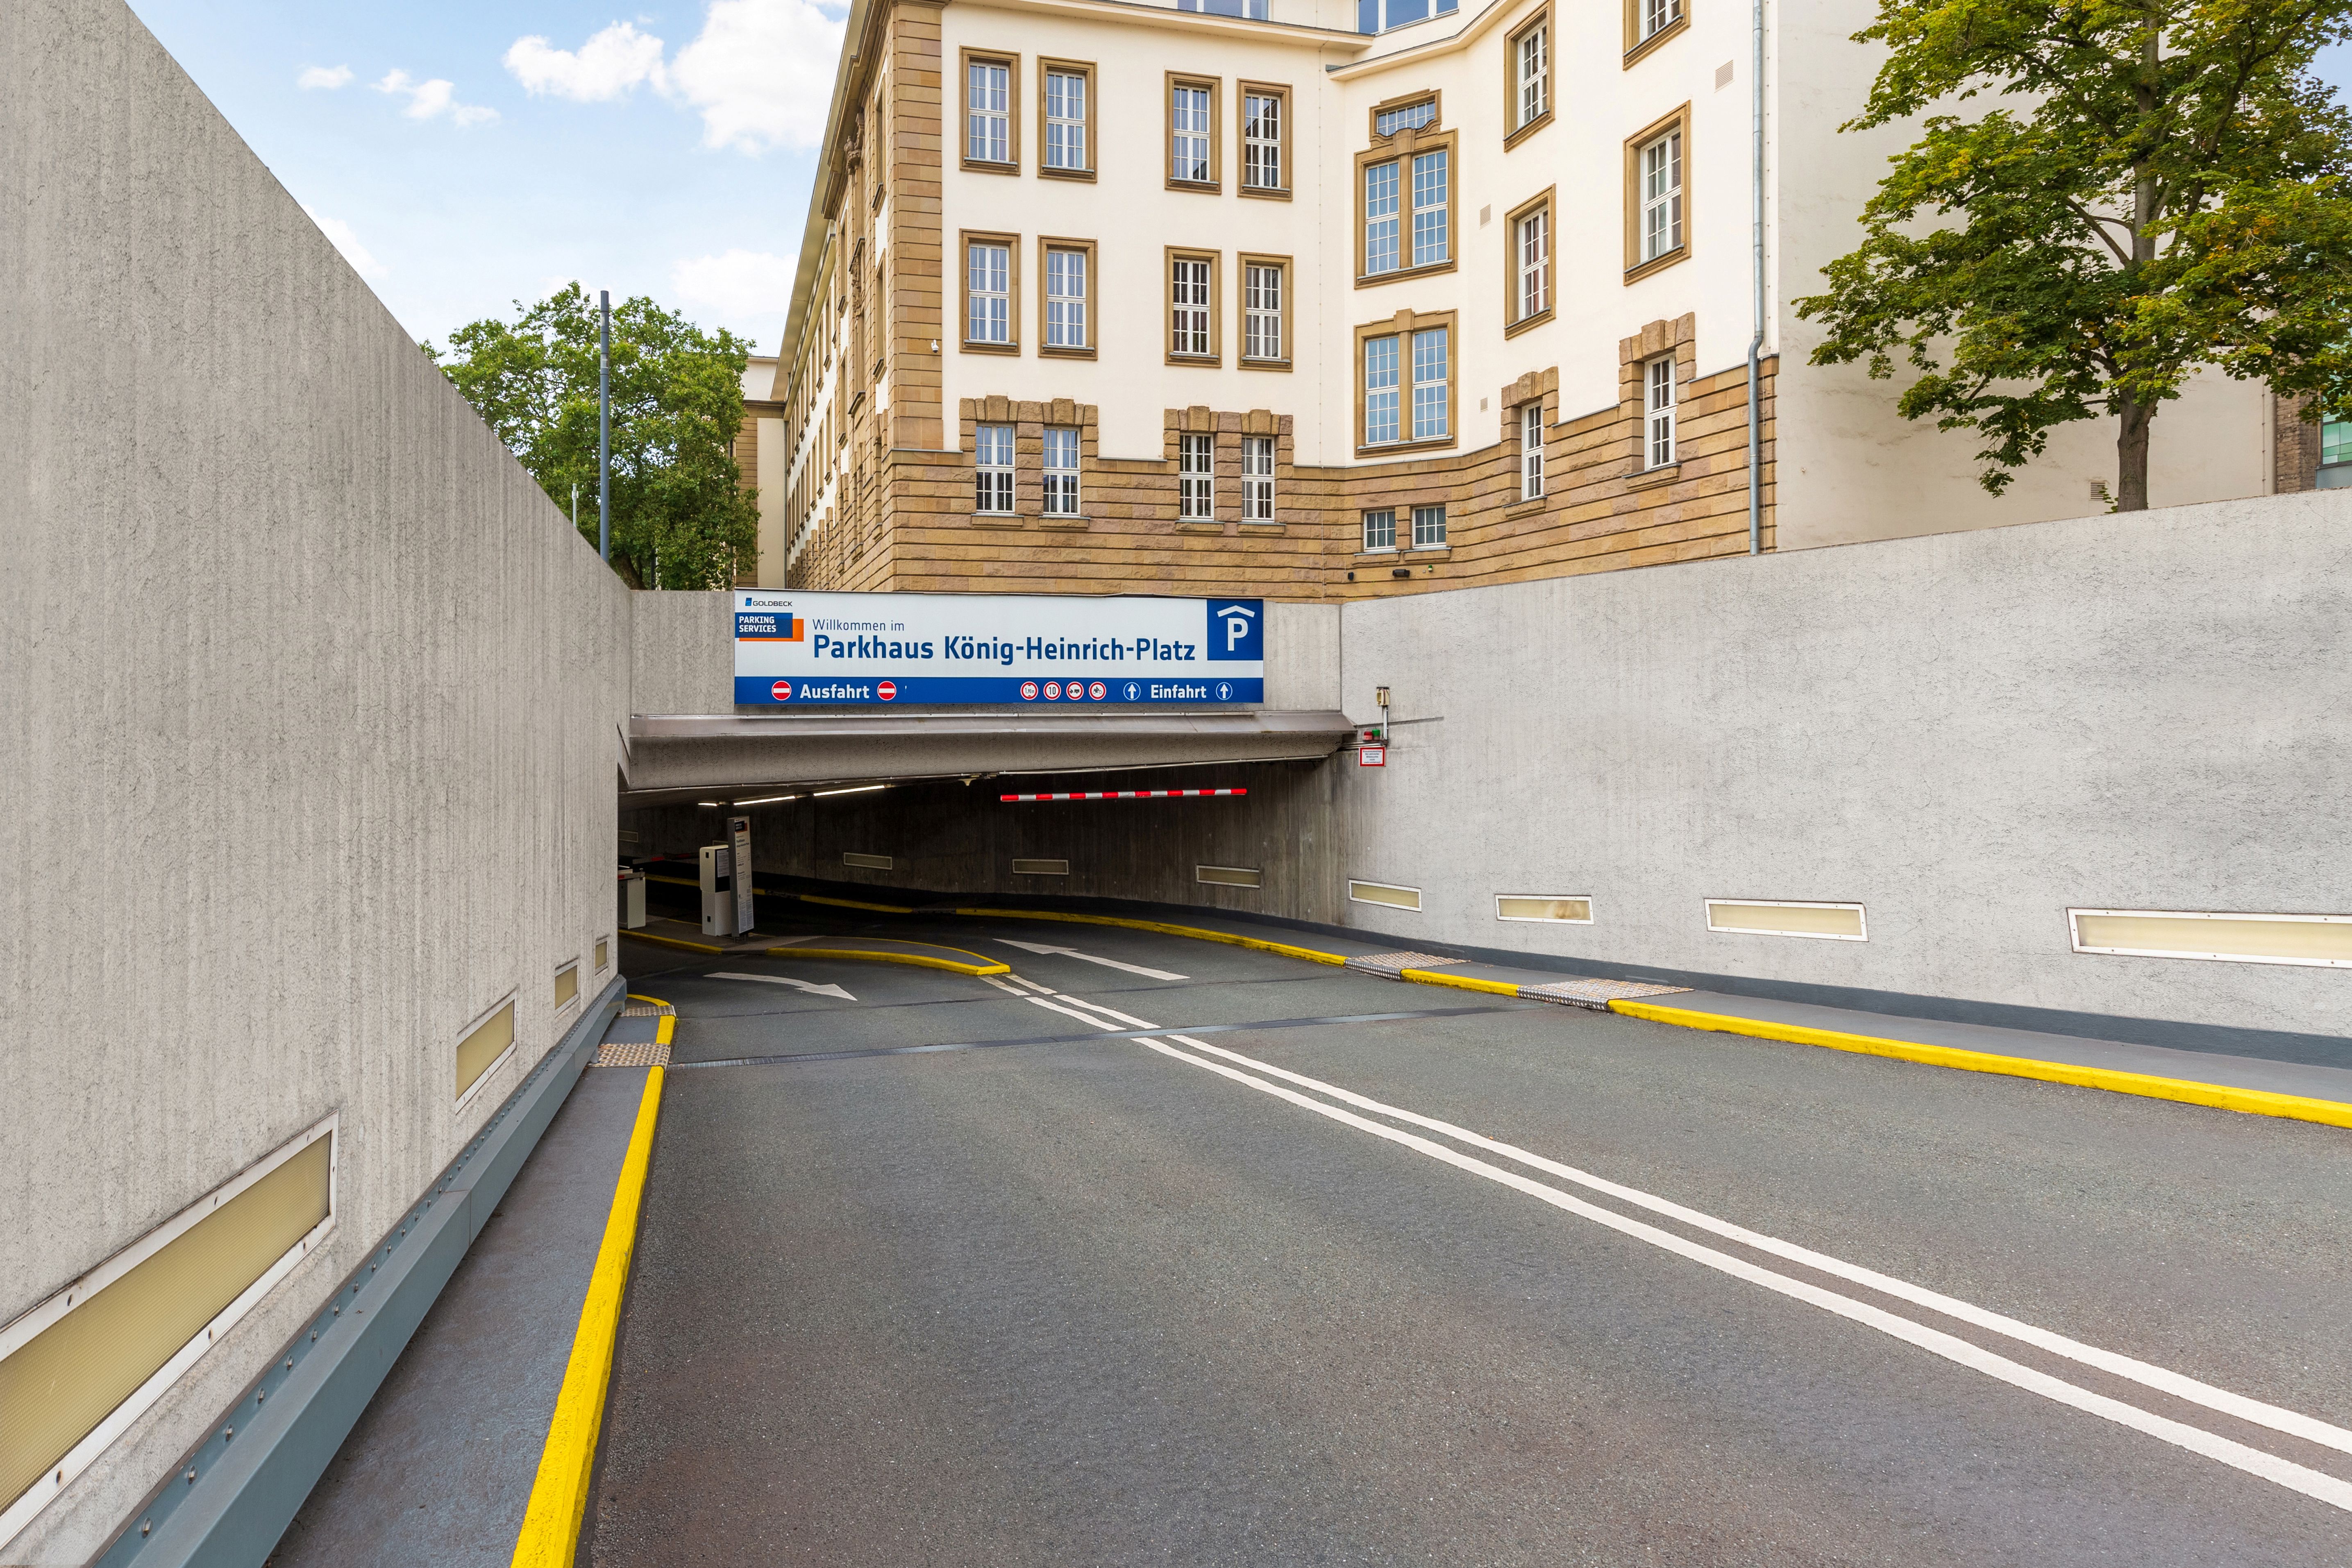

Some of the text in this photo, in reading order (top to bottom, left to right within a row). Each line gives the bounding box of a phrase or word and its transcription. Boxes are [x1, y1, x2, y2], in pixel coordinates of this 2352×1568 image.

[812, 619, 904, 631] Willkommen im
[1227, 617, 1249, 651] P
[814, 634, 1195, 666] Parkhaus König-Heinrich-Platz
[800, 684, 870, 699] Ausfahrt
[1049, 686, 1056, 695] 10
[1151, 684, 1207, 698] Einfahrt
